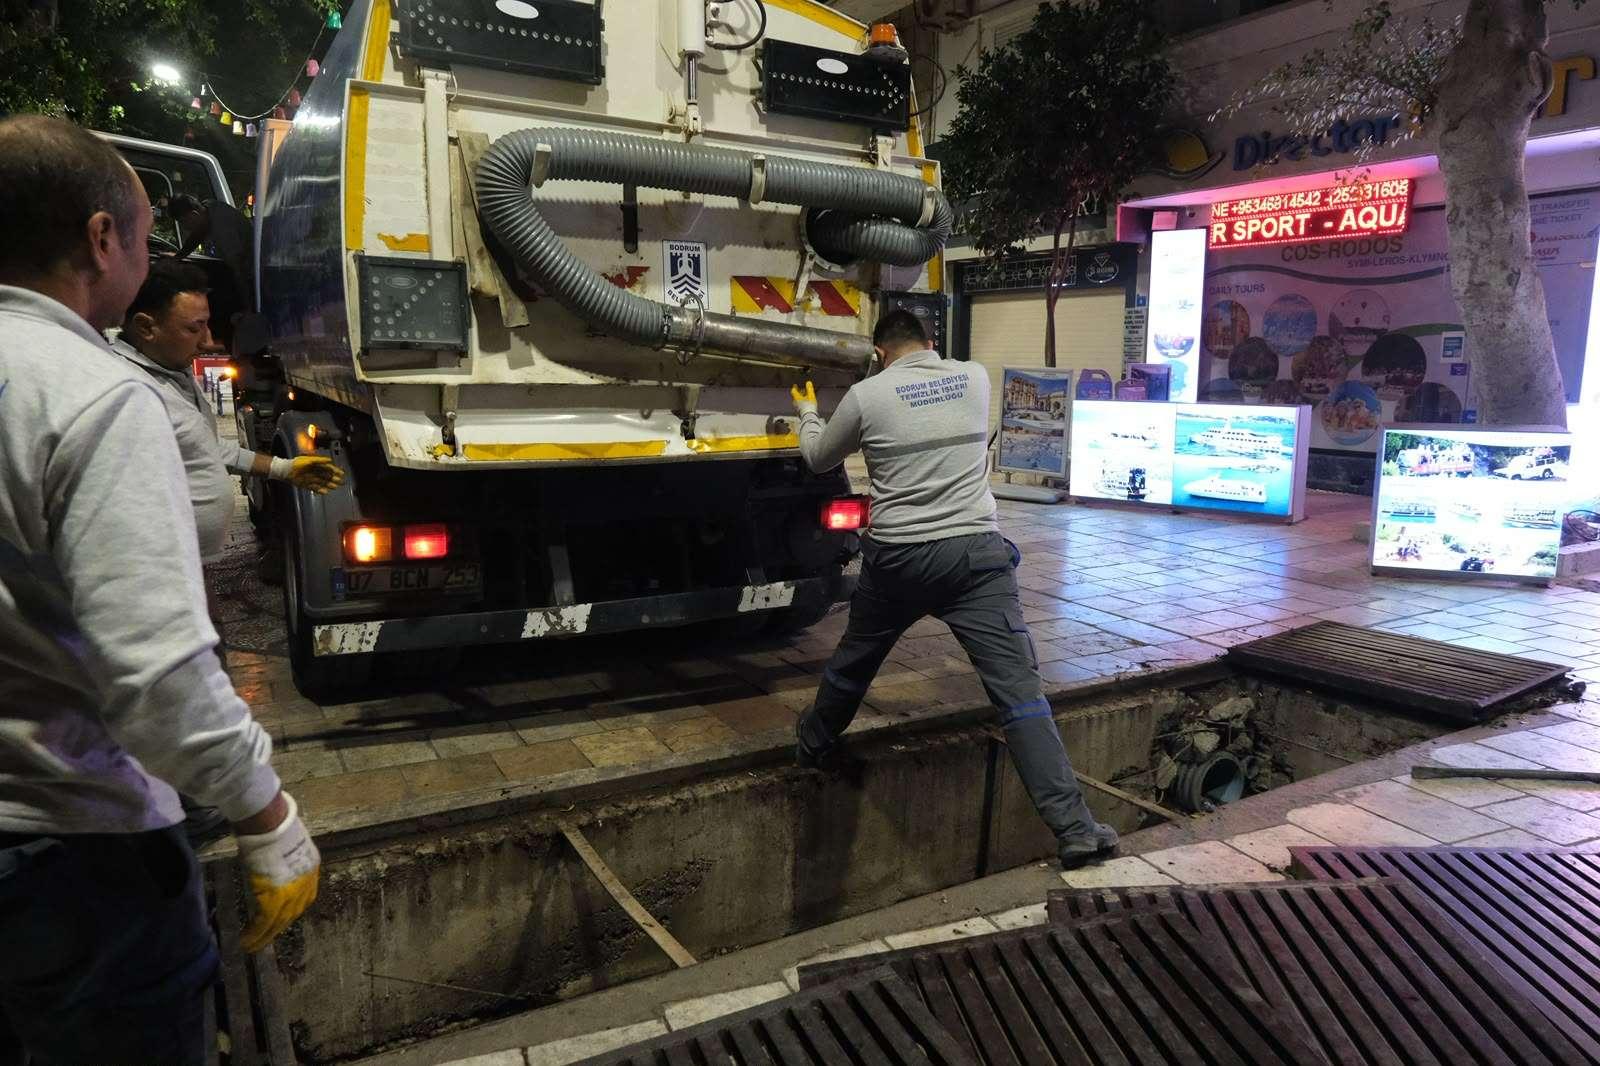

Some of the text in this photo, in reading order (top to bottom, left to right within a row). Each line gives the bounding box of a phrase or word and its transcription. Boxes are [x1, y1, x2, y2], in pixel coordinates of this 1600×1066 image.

[1233, 115, 1400, 172] Director
[1232, 213, 1310, 241] SPORT
[670, 244, 701, 252] BODRUM
[1281, 236, 1403, 262] COS-RODOS
[1208, 283, 1265, 296] DAILY TOURS
[895, 382, 928, 394] BODRUM
[900, 387, 940, 401] TEMİZLİK
